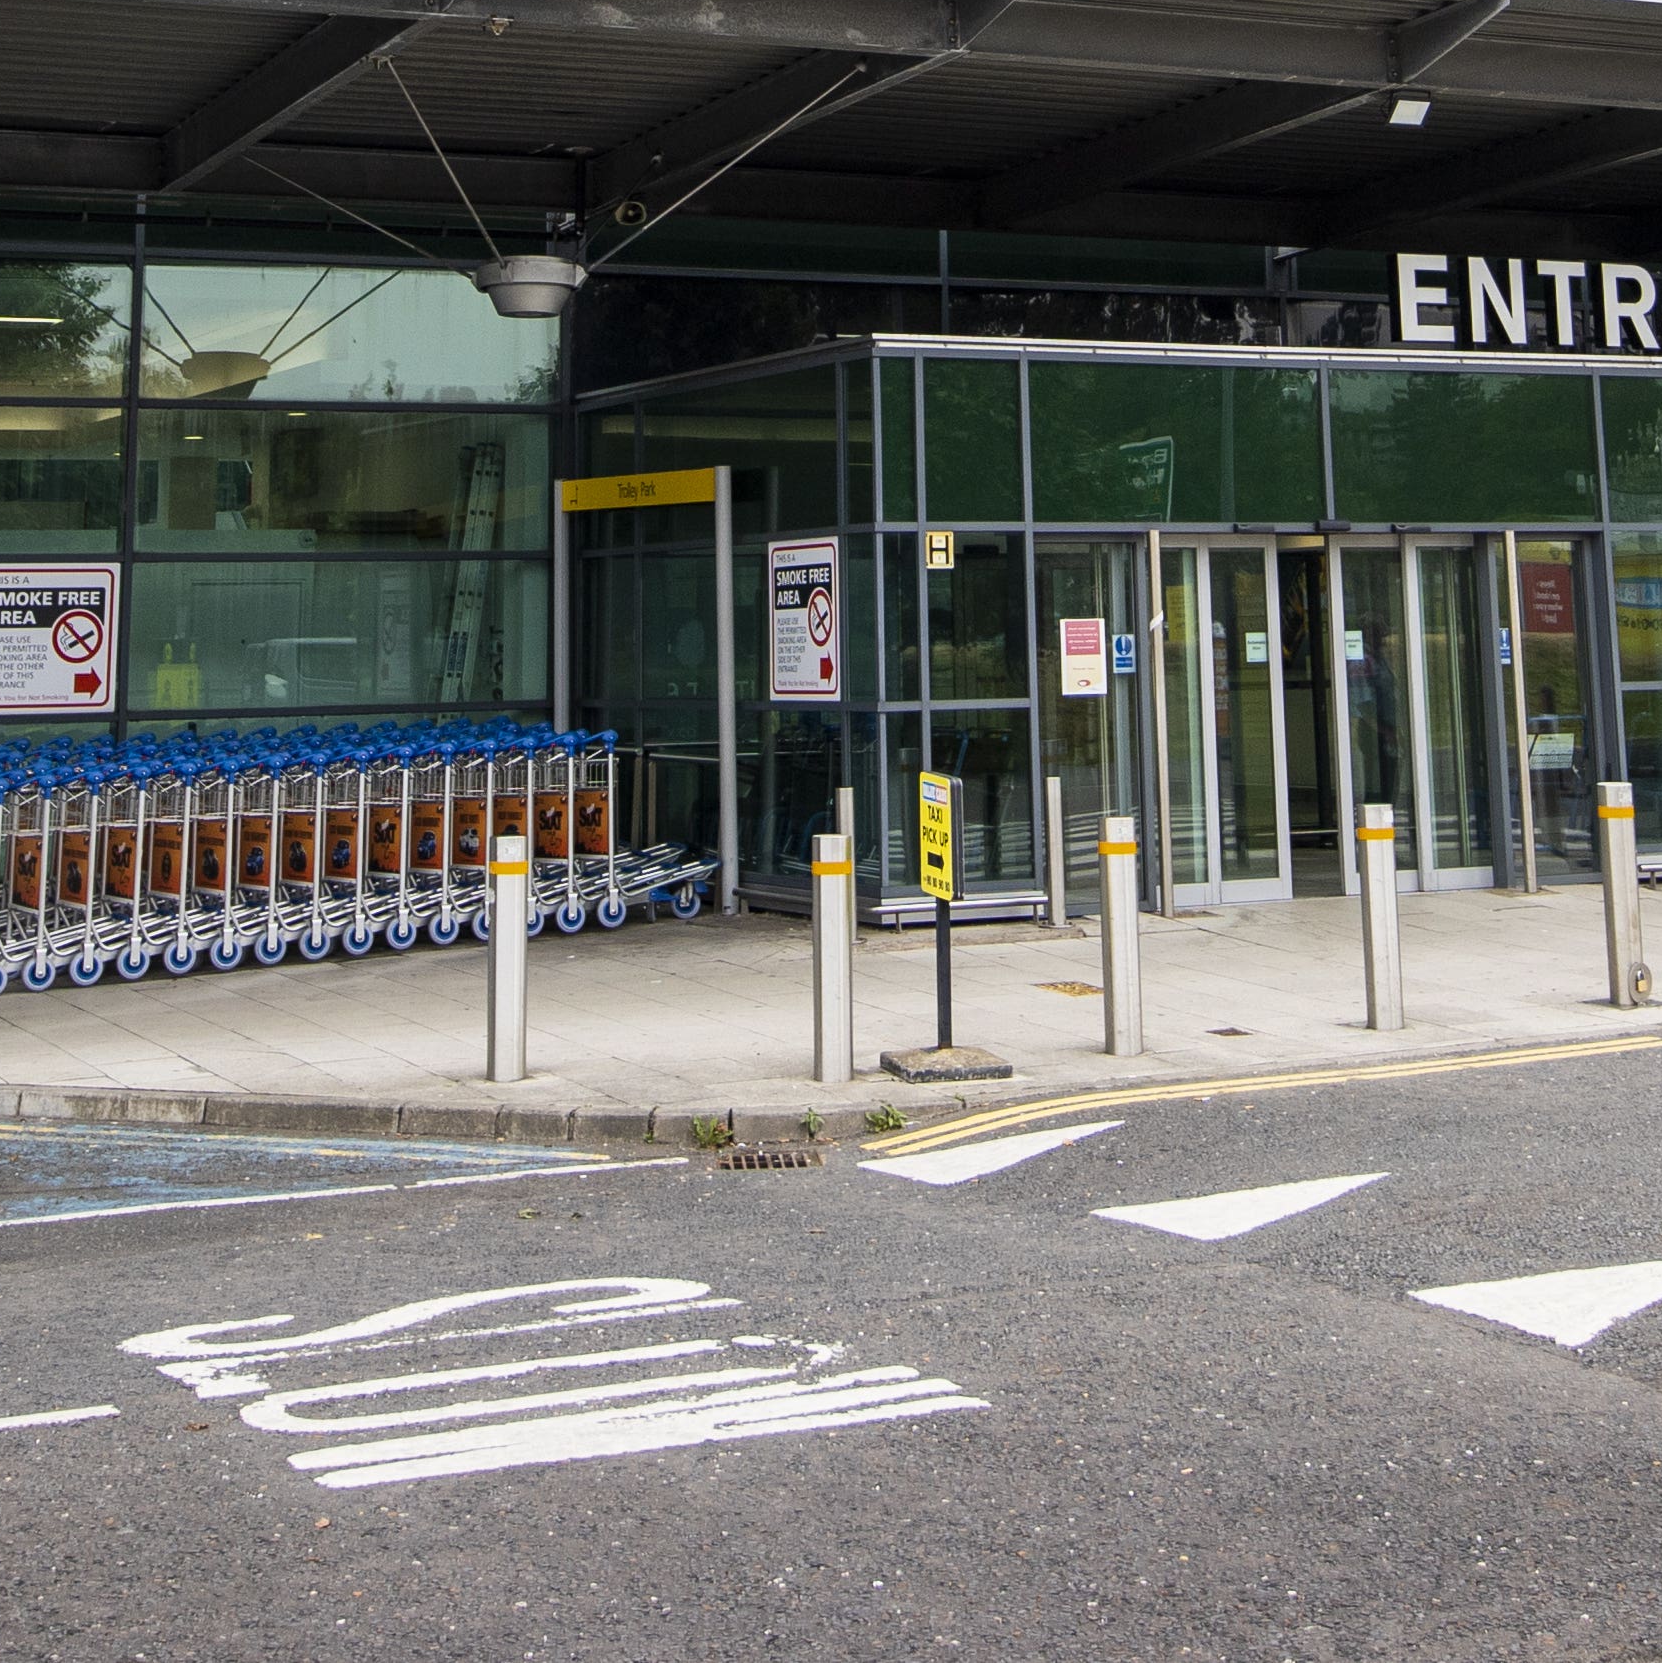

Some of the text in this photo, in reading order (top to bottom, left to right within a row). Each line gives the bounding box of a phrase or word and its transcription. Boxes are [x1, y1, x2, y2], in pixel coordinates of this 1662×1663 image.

[617, 480, 657, 501] Trolley Park
[776, 554, 787, 563] THIS
[11, 576, 20, 584] IS
[23, 576, 30, 584] A
[776, 567, 830, 586] SMOKE FREE
[58, 591, 101, 606] FREE
[777, 590, 800, 606] AREA
[3, 645, 48, 653] PERMITTED
[25, 653, 48, 661] AREA
[17, 662, 44, 670] OTHER
[17, 671, 34, 679] THIS
[42, 693, 69, 702] Smoking
[927, 805, 943, 824] TAXI
[922, 825, 949, 847] PICK UP
